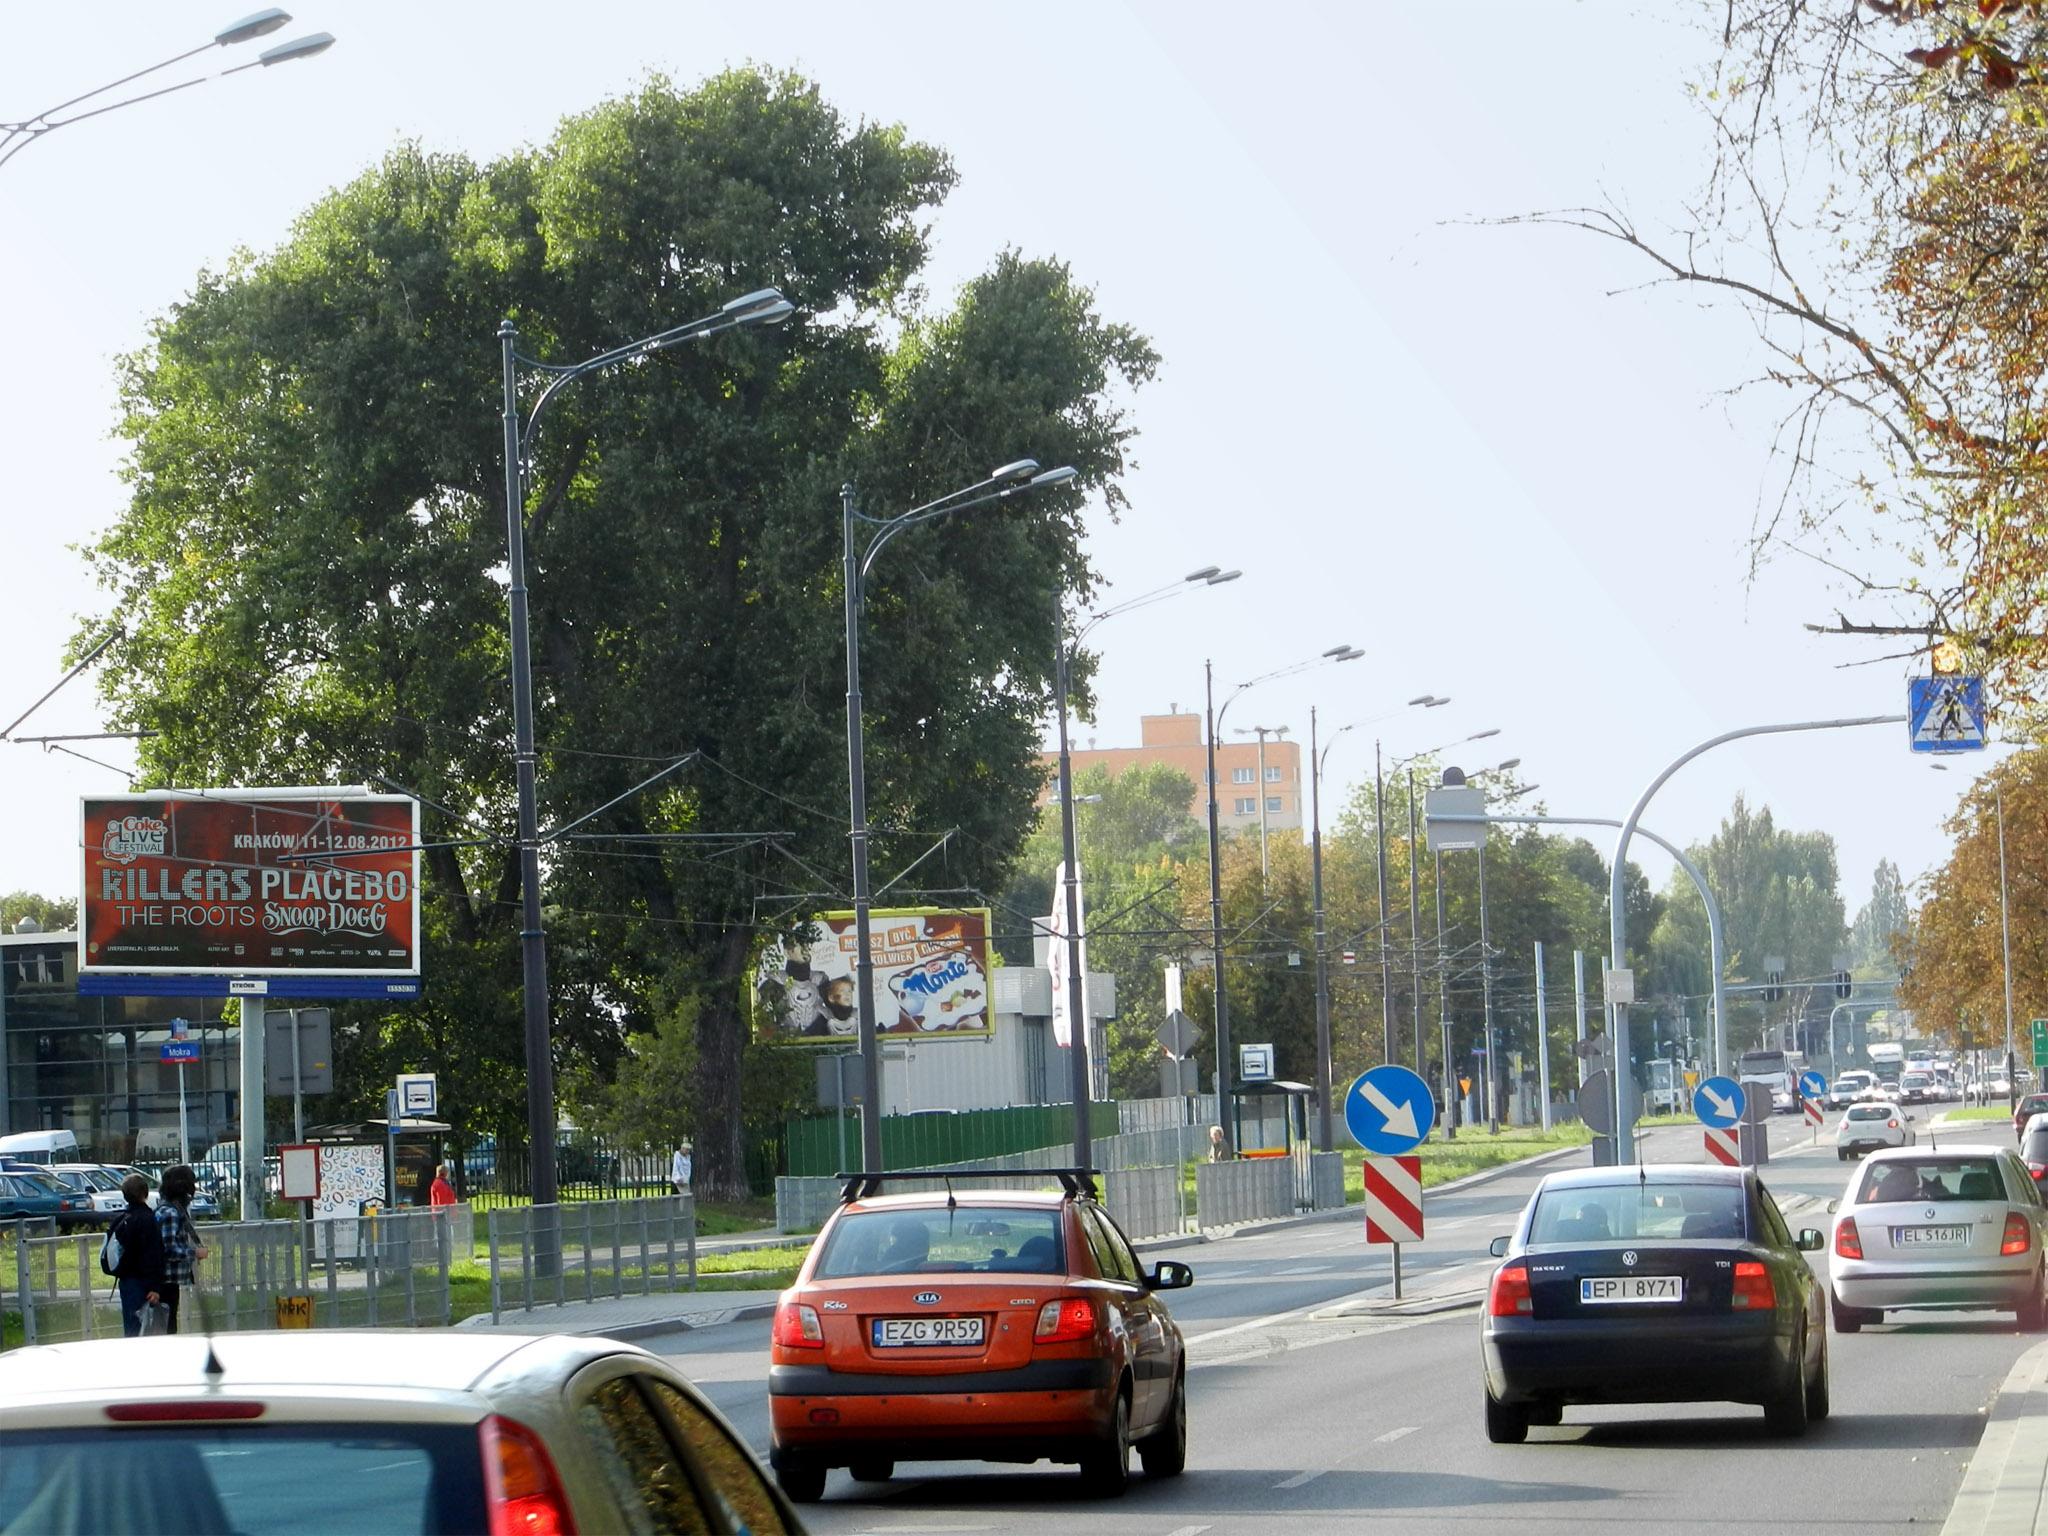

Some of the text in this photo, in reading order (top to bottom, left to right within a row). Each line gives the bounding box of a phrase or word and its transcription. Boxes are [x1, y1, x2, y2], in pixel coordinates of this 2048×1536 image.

[124, 817, 162, 831] Coke
[119, 843, 162, 852] FESTIVAL
[234, 832, 407, 848] KRAKÓW 11-12.08.2012
[261, 870, 407, 901] PLACEBO
[116, 906, 255, 926] THE ROOTS
[902, 961, 968, 996] Monte
[1904, 1230, 1963, 1242] EL 516JR
[1594, 1280, 1676, 1298] EPI 8Y71
[916, 1294, 938, 1302] KIA
[886, 1320, 979, 1340] EZG 9R59
